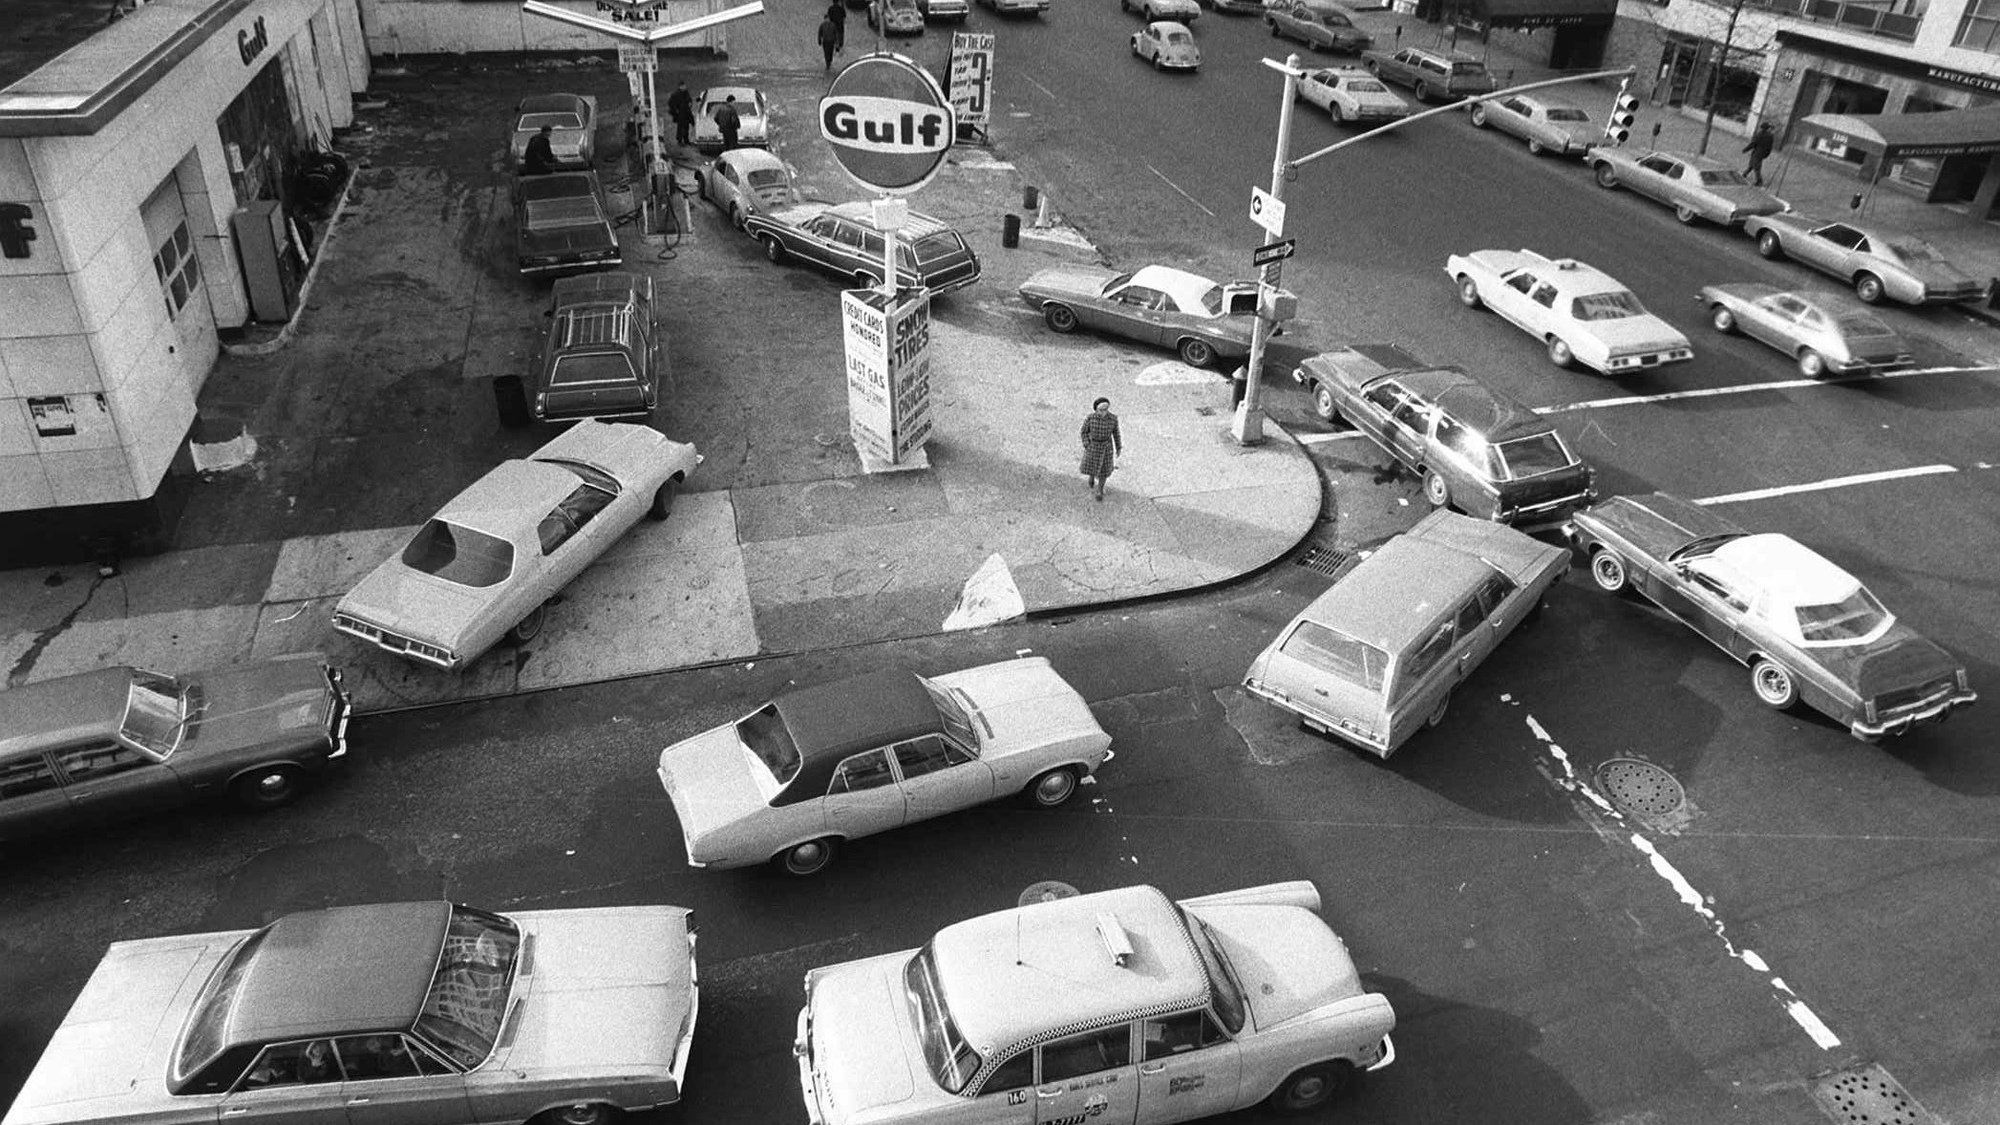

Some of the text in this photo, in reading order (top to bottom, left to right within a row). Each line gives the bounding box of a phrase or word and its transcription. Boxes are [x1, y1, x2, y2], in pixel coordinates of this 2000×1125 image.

[611, 10, 659, 22] SALE!
[238, 15, 268, 67] Gulf
[824, 102, 942, 147] Gulf
[844, 300, 884, 334] CREDIT CARDS
[850, 320, 881, 348] HONORED
[896, 300, 929, 345] SNOW
[895, 322, 929, 368] TIRES
[848, 354, 866, 377] LAST
[867, 367, 885, 389] GAS
[898, 375, 929, 421] PRICES
[1009, 1091, 1026, 1104] 160
